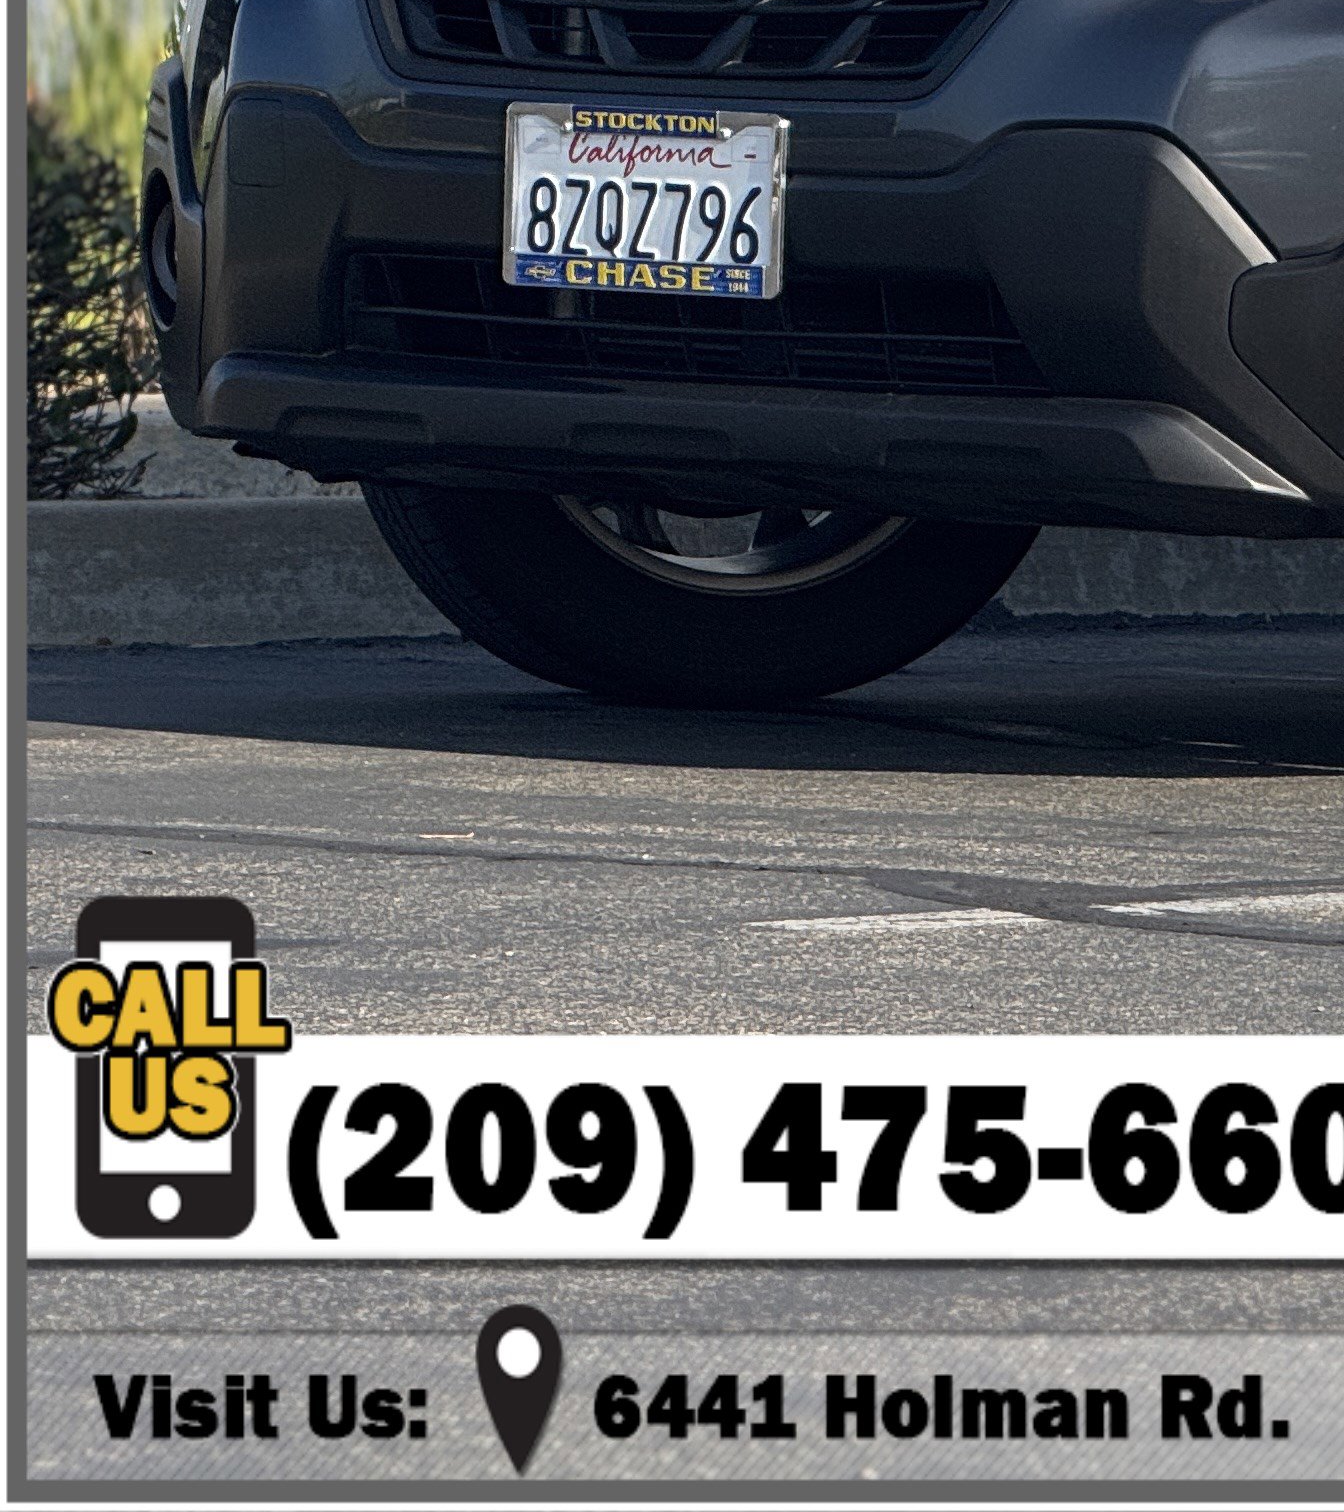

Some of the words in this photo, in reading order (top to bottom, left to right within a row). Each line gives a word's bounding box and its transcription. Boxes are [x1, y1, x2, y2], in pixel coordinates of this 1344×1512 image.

[575, 111, 716, 133] STOCKTON
[568, 133, 732, 178] California
[528, 178, 762, 264] 8ZQZ796
[565, 260, 715, 291] CHASE
